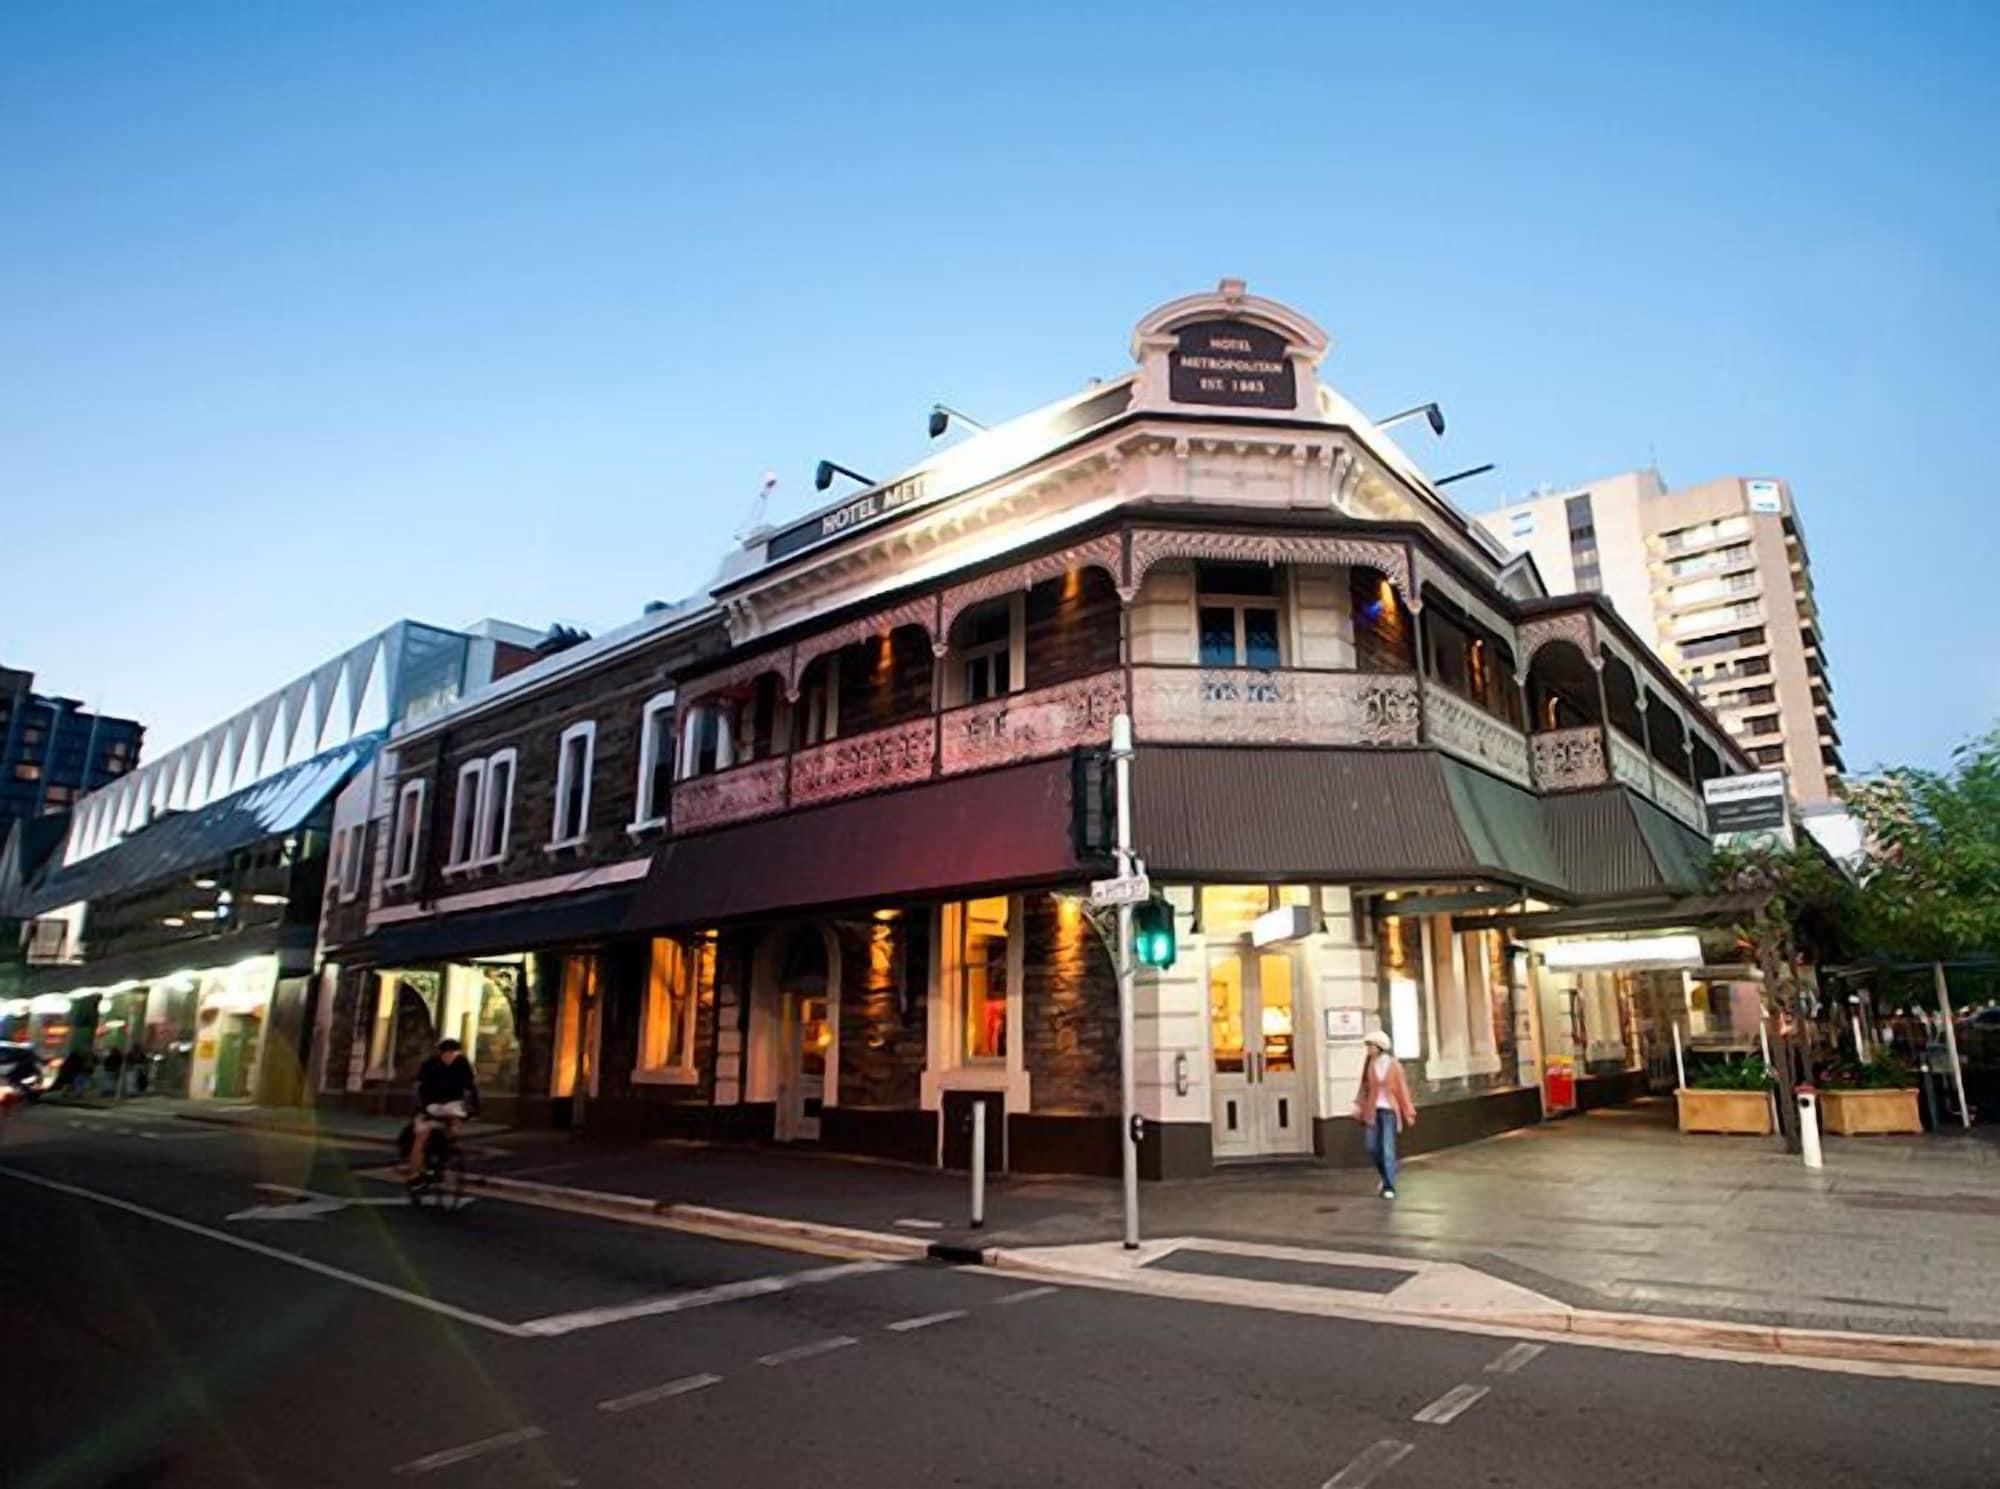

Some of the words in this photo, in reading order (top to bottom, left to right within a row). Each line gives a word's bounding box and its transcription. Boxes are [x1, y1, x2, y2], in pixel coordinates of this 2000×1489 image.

[1209, 338, 1251, 352] HOTEL
[1181, 357, 1283, 373] METROPOLITAN
[822, 497, 877, 535] HOTEL
[883, 481, 923, 508] MET
